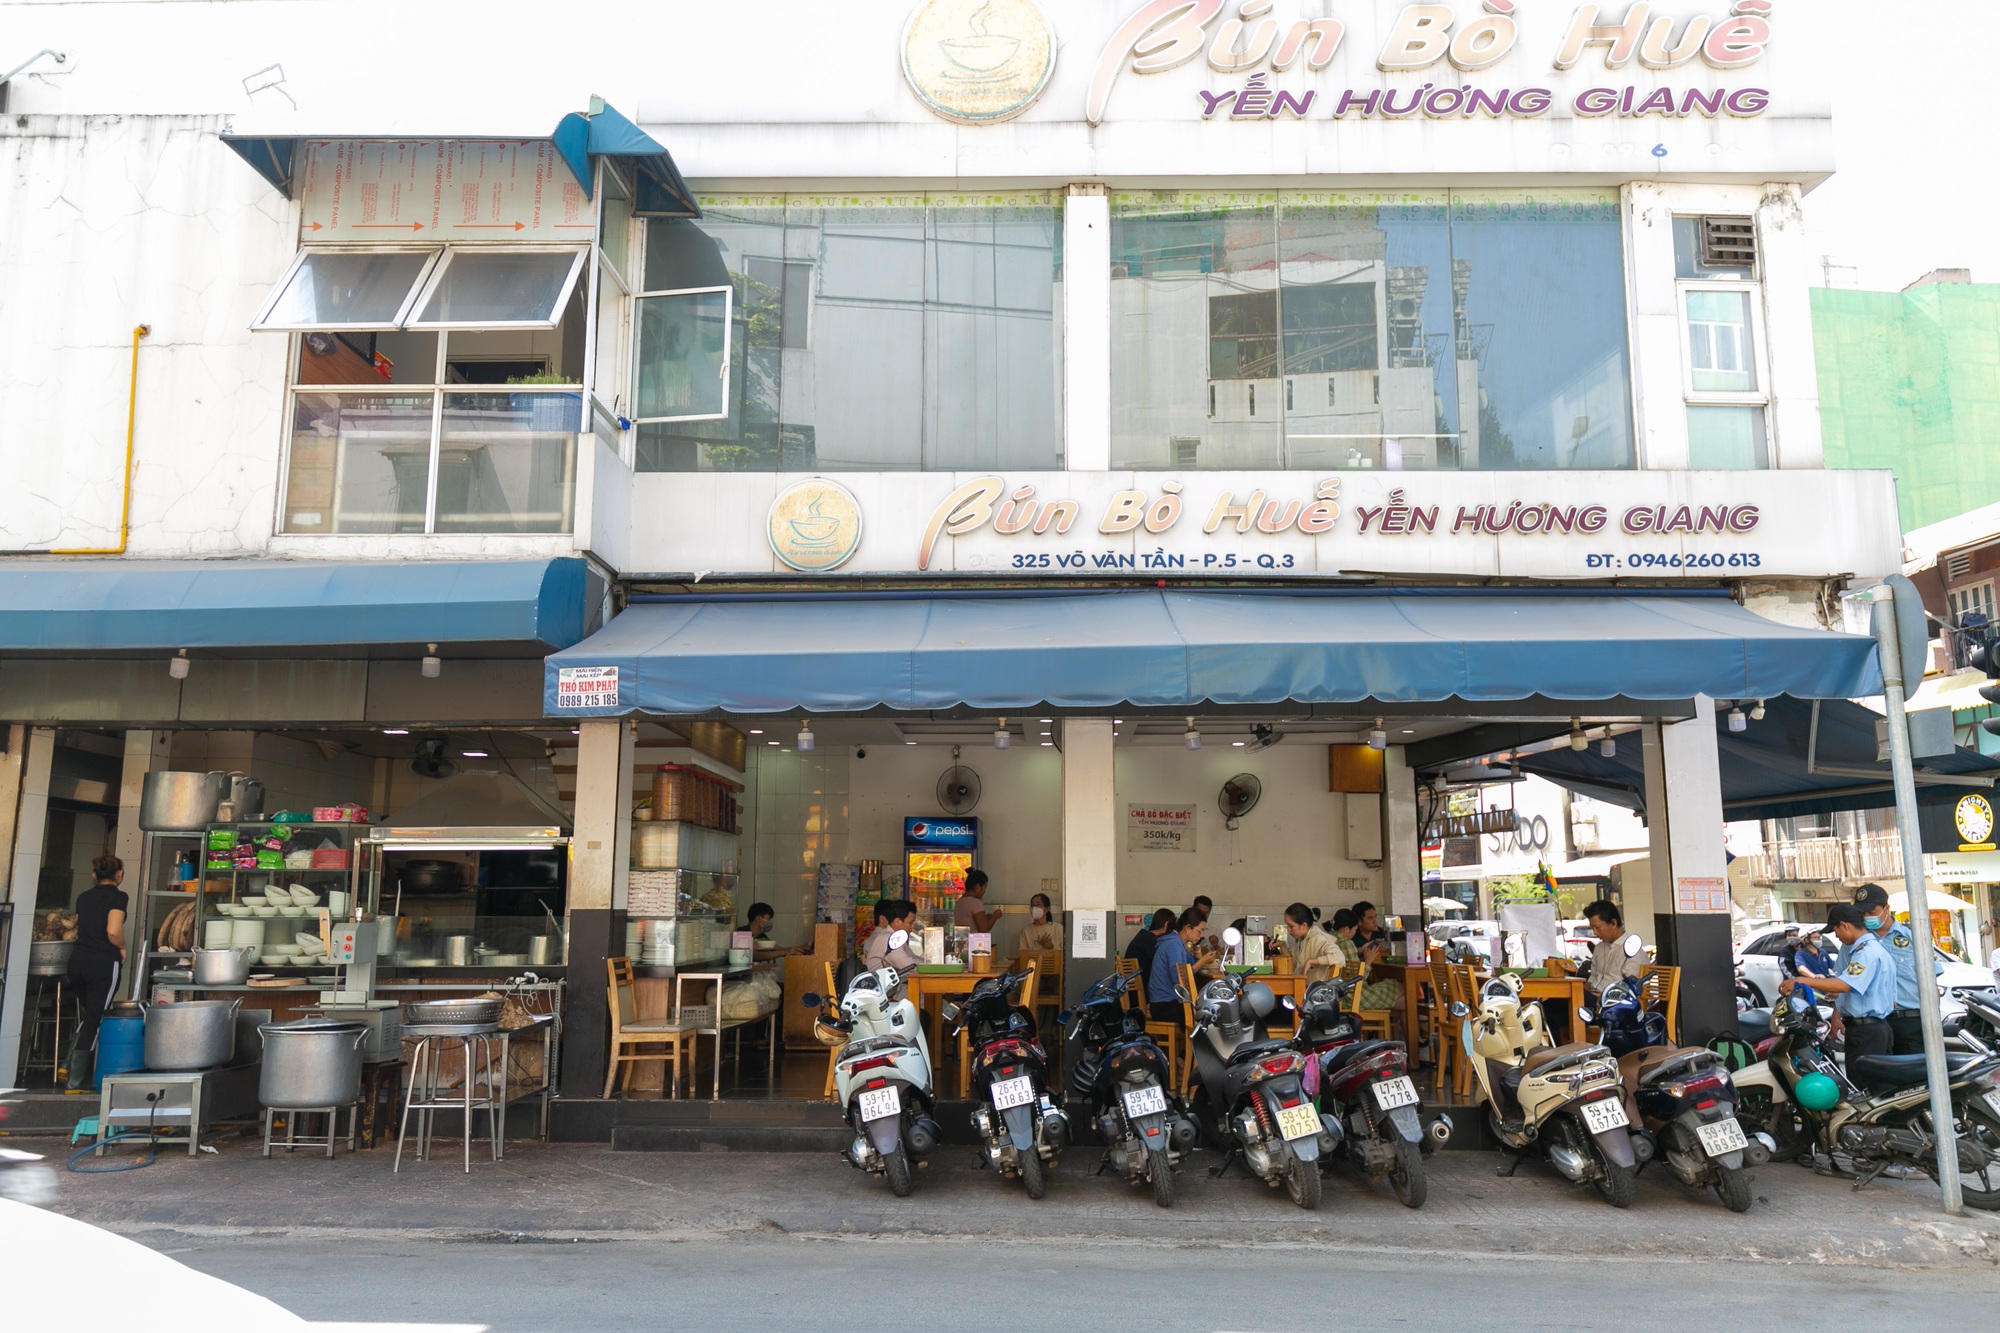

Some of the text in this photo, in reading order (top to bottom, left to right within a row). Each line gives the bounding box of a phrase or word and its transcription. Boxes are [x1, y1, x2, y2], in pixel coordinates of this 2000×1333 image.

[1198, 71, 1771, 118] YẾN HƯƠNG GIANG
[333, 164, 342, 205] COMPOSITE
[434, 164, 442, 205] COMPOSITE
[535, 164, 543, 205] COMPOSITE
[1355, 488, 1761, 535] YẾN HƯƠNG GIANG
[917, 475, 1342, 571] Bún Bò Huế
[1011, 554, 1050, 568] 325
[1056, 550, 1087, 568] VÕ
[1092, 549, 1136, 568] VĂN
[1141, 546, 1184, 568] TẦN
[1203, 554, 1237, 568] P.5
[1257, 554, 1295, 569] Q.3
[579, 681, 595, 692] KIM
[560, 694, 616, 706] 0989 215 185
[1131, 808, 1145, 817] CHẢ
[1148, 809, 1157, 818] BÒ
[1175, 810, 1191, 820] BIỆT
[935, 824, 969, 837] pepsi
[1143, 830, 1181, 841] 350k/kg
[998, 1080, 1024, 1095] 26-F1
[1130, 1088, 1158, 1104] 59-M2
[1380, 1080, 1406, 1095] 47-R1
[865, 1090, 891, 1106] 59-F1
[998, 1090, 1030, 1108] 118.63
[1383, 1091, 1412, 1107] 1778
[864, 1101, 897, 1119] 964.94
[1130, 1099, 1164, 1116] 634.70
[1282, 1106, 1311, 1124] 59-C2
[1587, 1101, 1617, 1117] 59-K2
[1283, 1119, 1318, 1139] 707.51
[1704, 1122, 1735, 1140] 59-P2
[1706, 1133, 1744, 1154] 169.95
